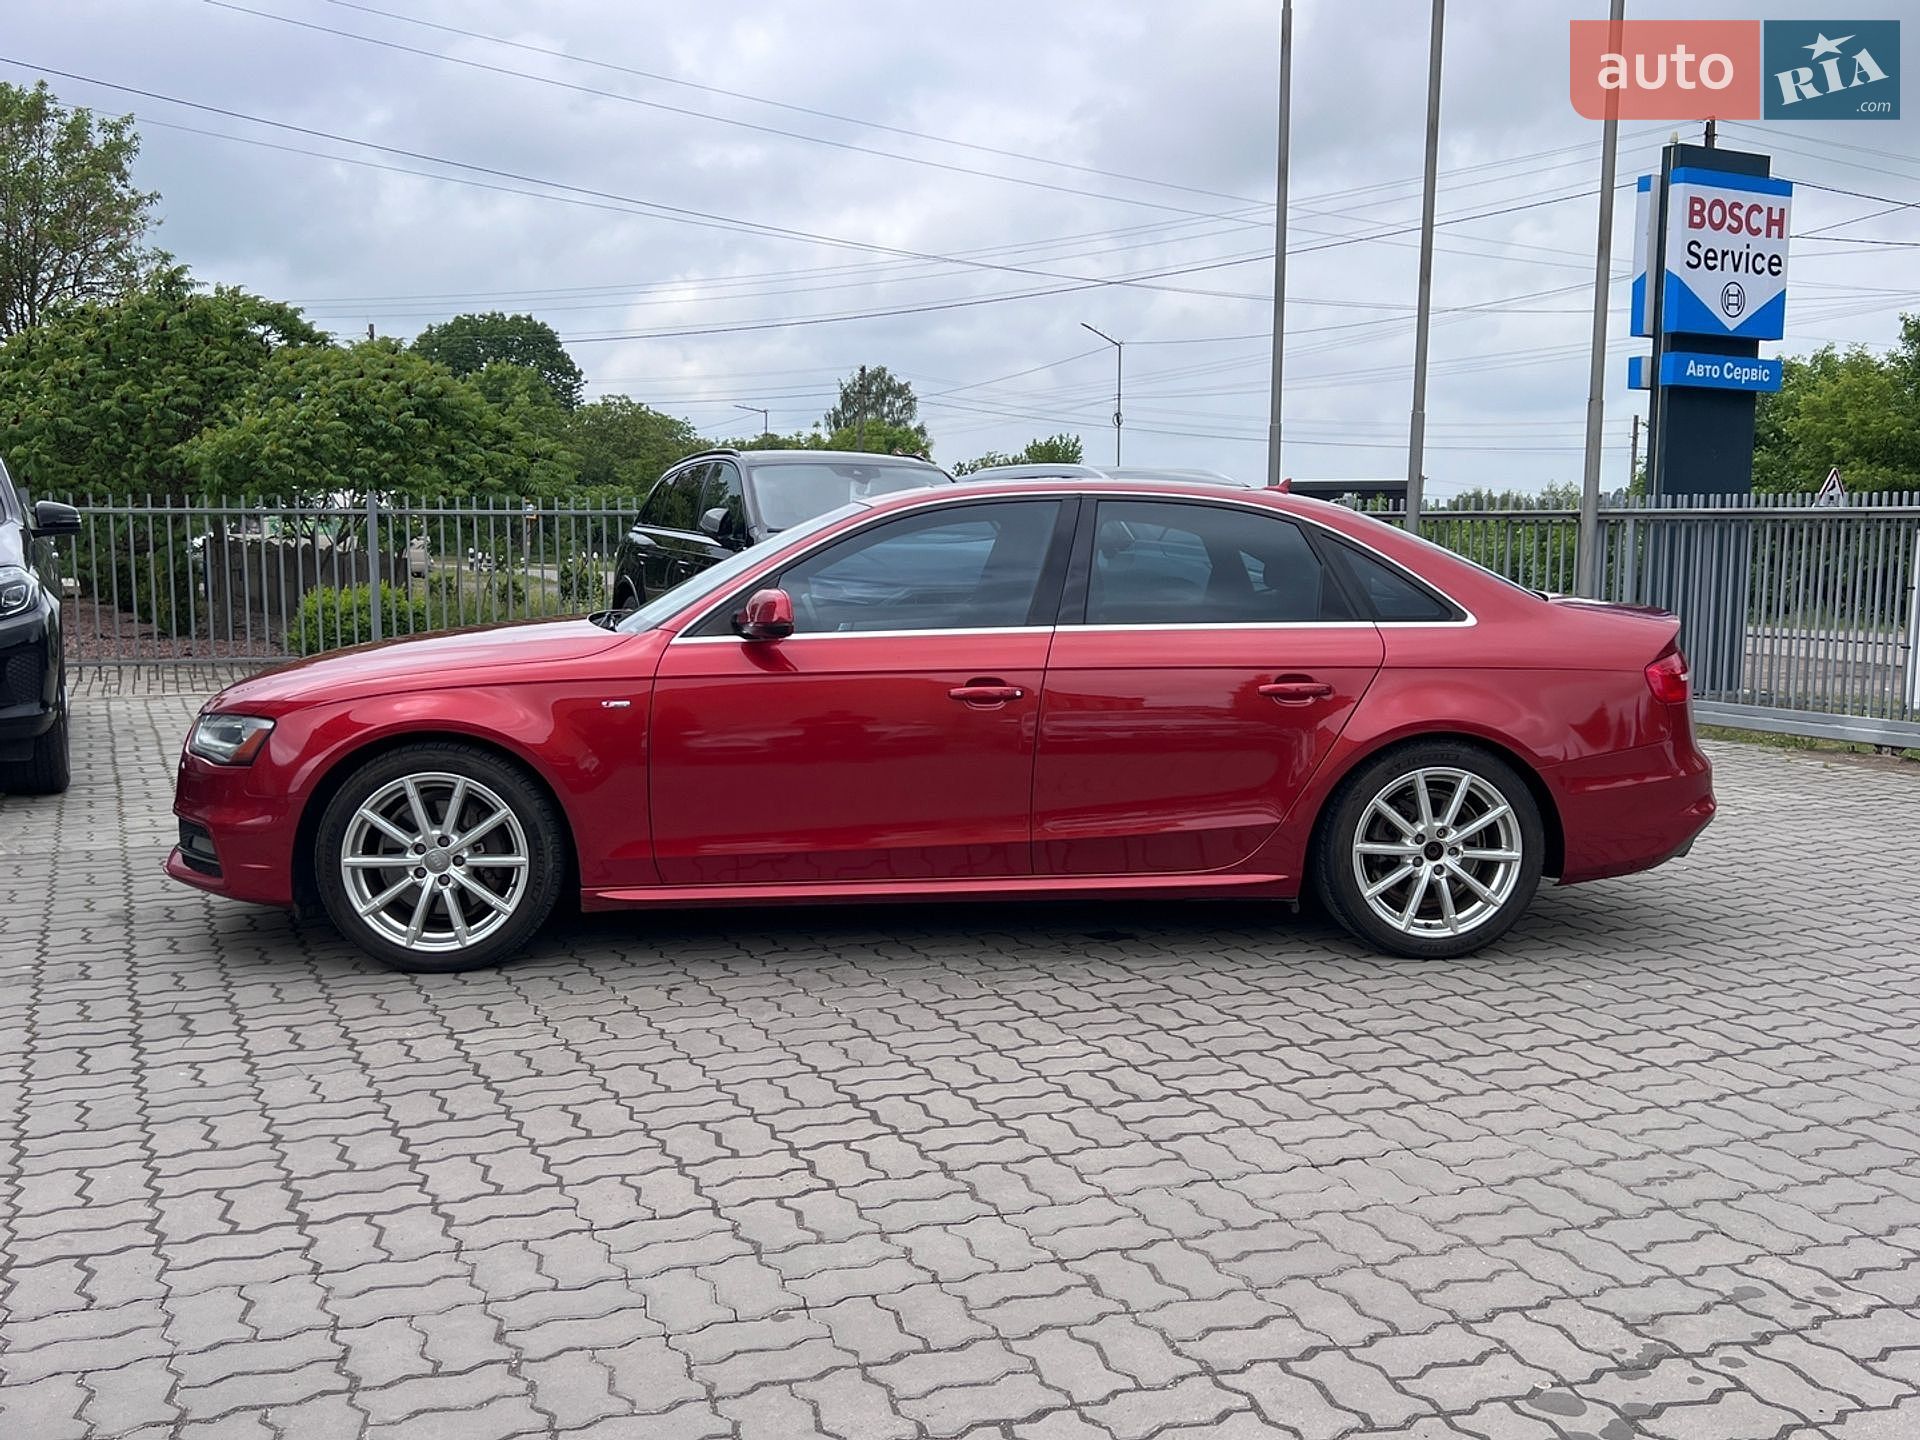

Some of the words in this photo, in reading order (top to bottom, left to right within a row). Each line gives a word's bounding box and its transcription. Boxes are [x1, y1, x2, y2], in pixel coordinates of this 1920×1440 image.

[1688, 197, 1785, 239] BOSCH
[1686, 241, 1783, 276] Service
[1686, 360, 1719, 379] Авто
[1723, 362, 1770, 384] Сервіс
